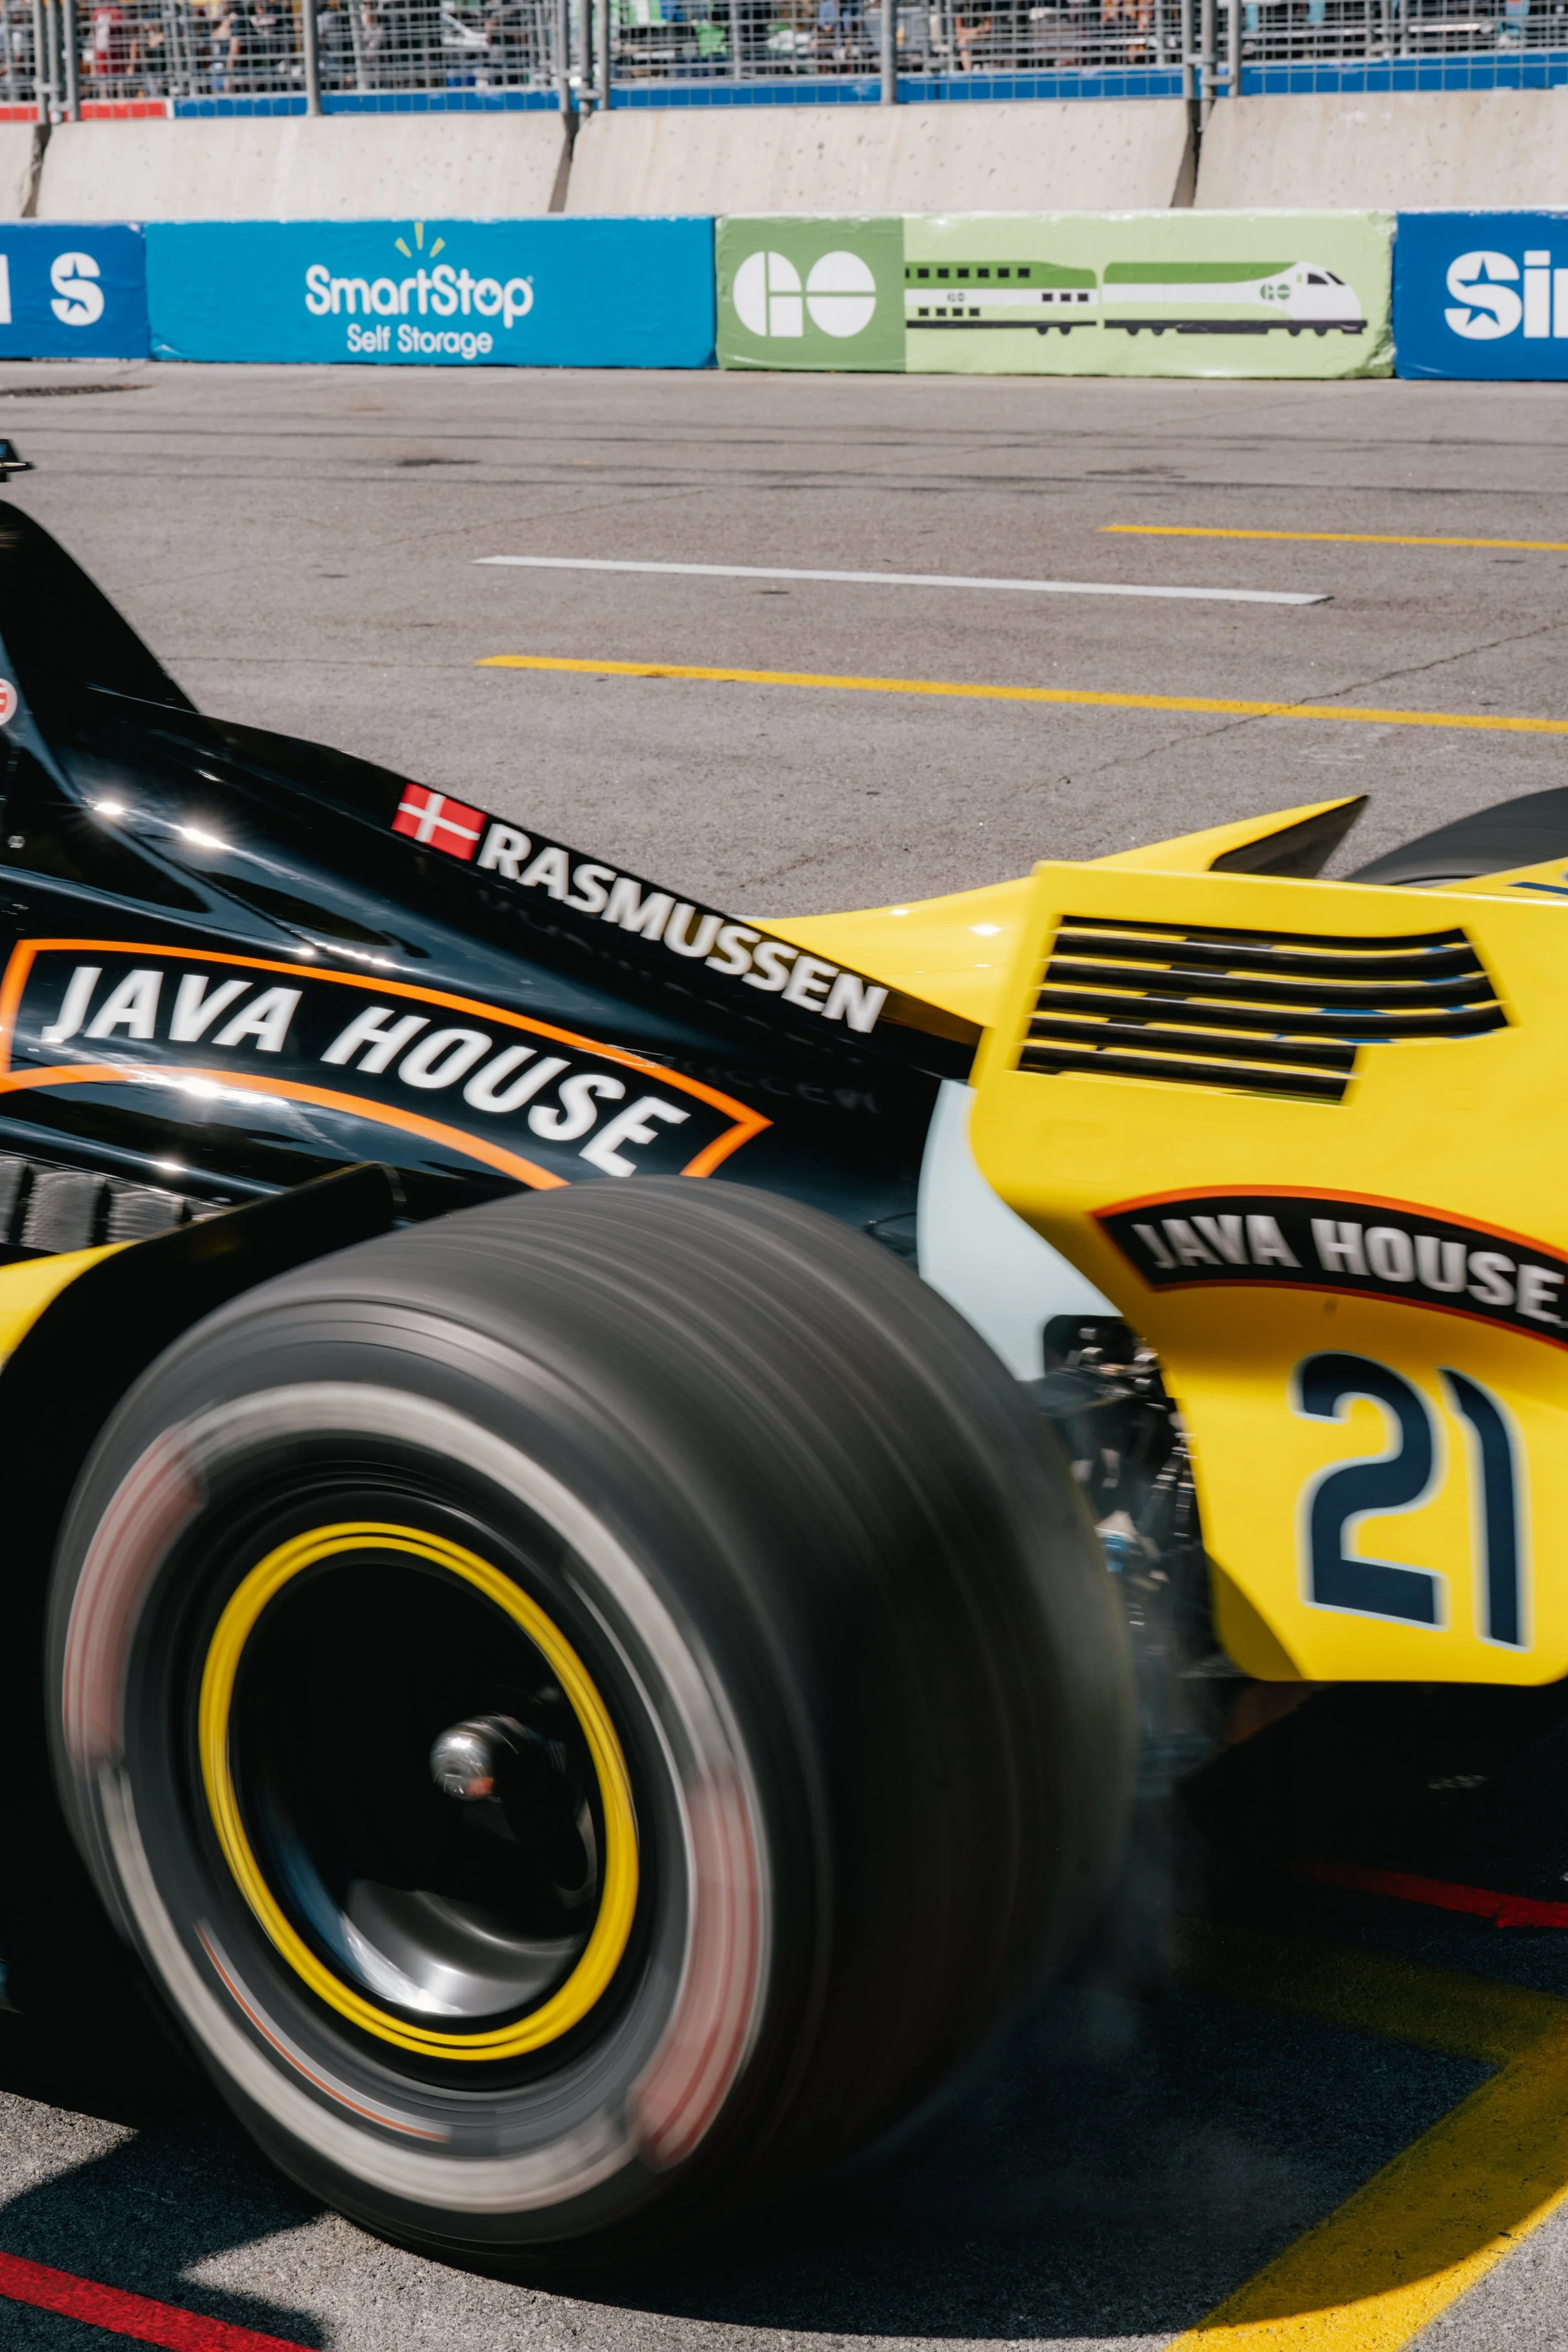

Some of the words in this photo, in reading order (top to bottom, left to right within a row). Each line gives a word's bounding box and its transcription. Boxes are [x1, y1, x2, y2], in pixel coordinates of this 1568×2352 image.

[305, 264, 534, 329] SmartStop
[347, 323, 391, 352] Self
[397, 324, 494, 361] Storage
[733, 251, 876, 338] GO
[477, 822, 889, 1034] RASMUSSEN
[41, 967, 303, 1052] JAVA
[320, 1006, 691, 1177] HOUSE
[1132, 1214, 1303, 1270] JAVA
[1311, 1219, 1565, 1325] HOUSE
[1290, 1350, 1530, 1651] 21
